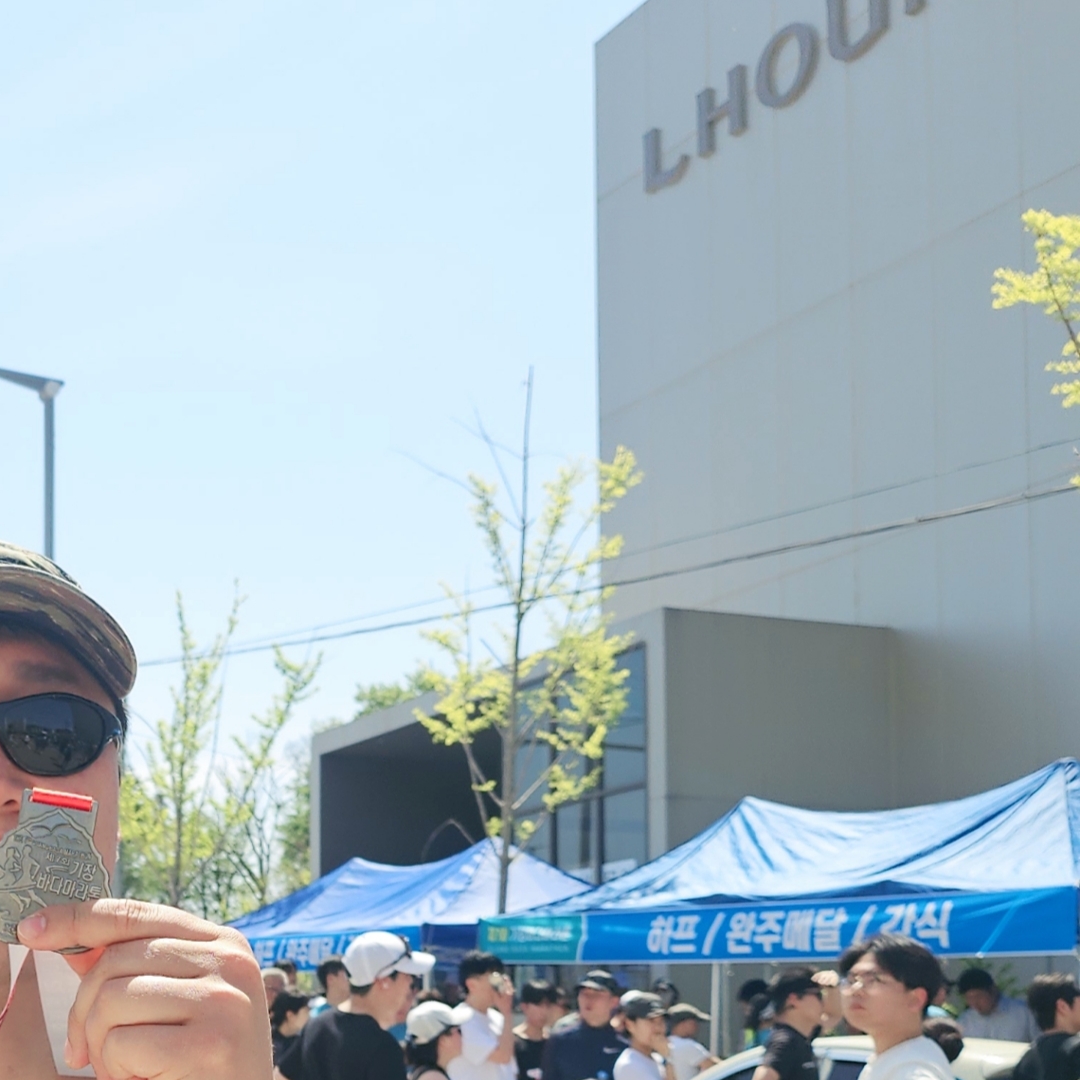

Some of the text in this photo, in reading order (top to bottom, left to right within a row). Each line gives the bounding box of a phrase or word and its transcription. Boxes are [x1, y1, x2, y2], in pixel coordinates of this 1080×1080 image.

[642, 0, 926, 194] LHOU
[36, 872, 102, 901] 바다마라톤
[69, 861, 97, 882] 기장
[646, 915, 701, 954] 하프
[726, 907, 848, 954] 완주메달
